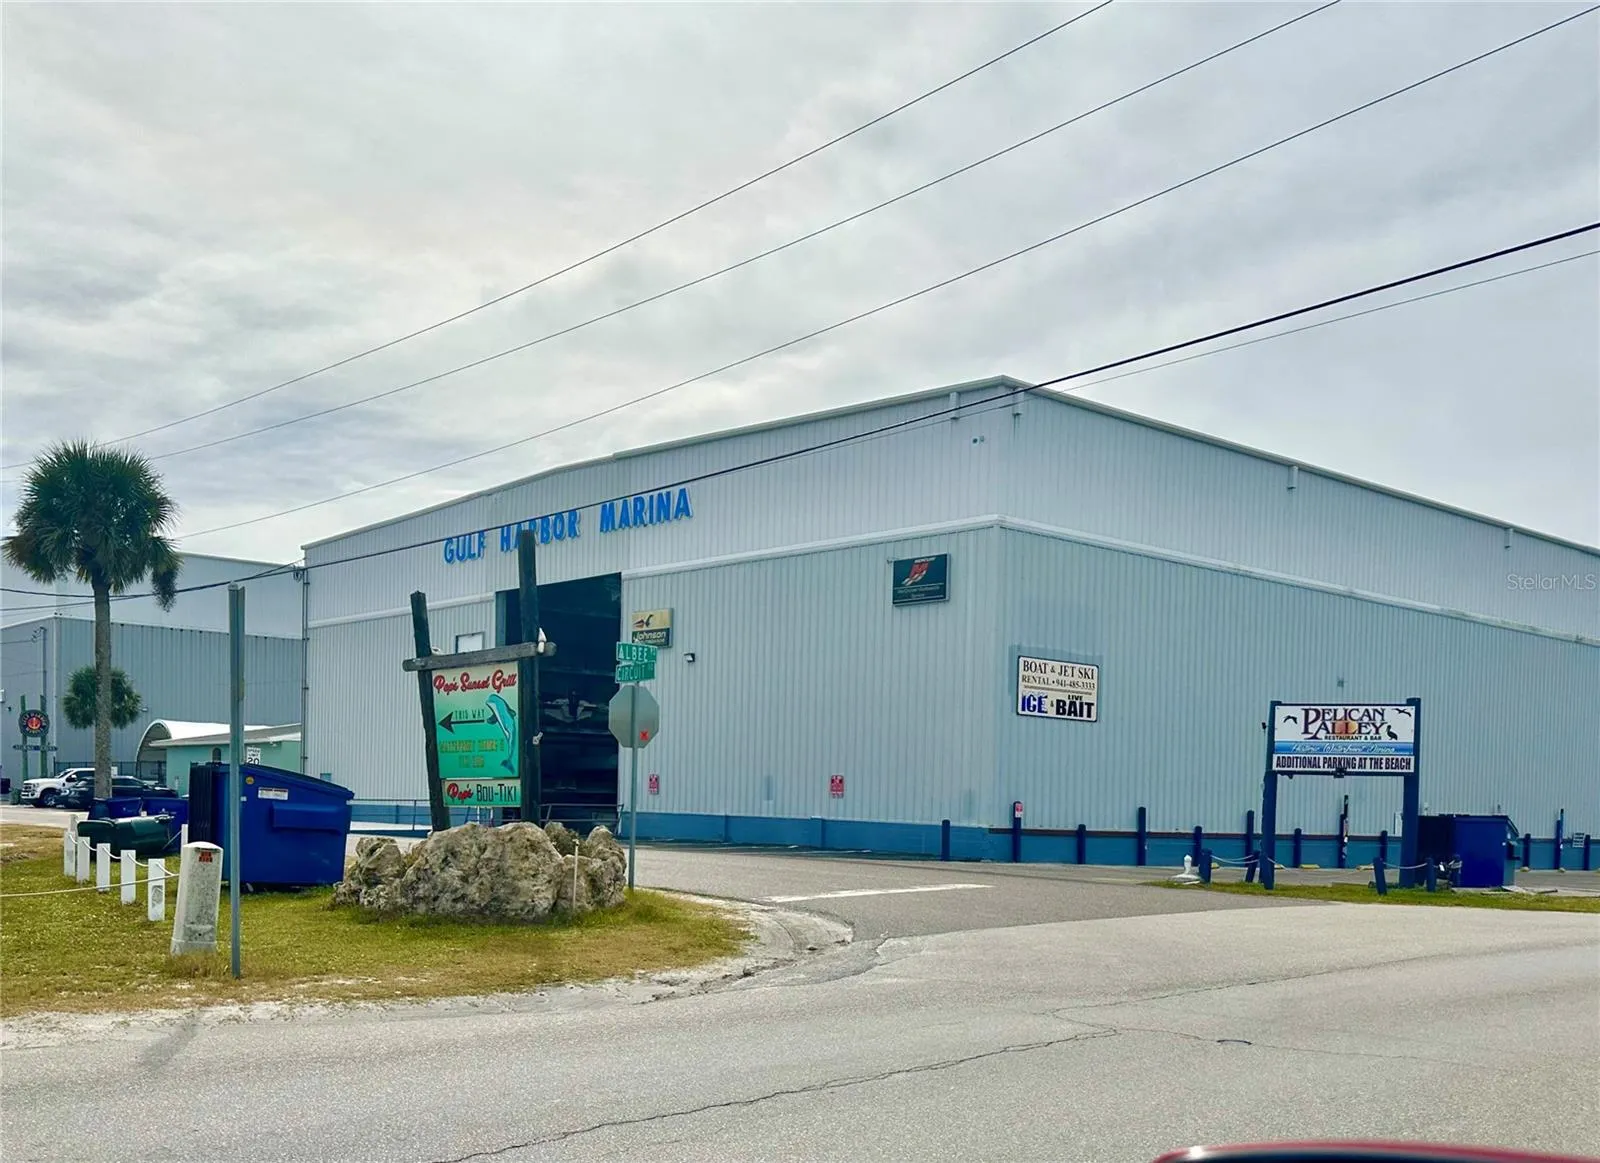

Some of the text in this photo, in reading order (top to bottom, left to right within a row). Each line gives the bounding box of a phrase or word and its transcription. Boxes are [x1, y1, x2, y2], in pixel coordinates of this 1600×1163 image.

[443, 531, 487, 564] GULF
[599, 487, 693, 534] MARINA
[633, 631, 667, 642] Johnson
[618, 645, 648, 662] ALBEE
[617, 664, 646, 681] CIRCUIT
[1023, 660, 1095, 680] BOAT & JET SKI
[460, 671, 490, 692] Sunset
[491, 669, 517, 694] Grill
[1022, 675, 1050, 686] RENTAL
[1021, 693, 1048, 714] ICE
[1055, 698, 1095, 718] BAIT
[1301, 707, 1386, 735] PELICAN
[1303, 720, 1389, 741] ALLEY
[247, 757, 260, 766] 20
[1275, 756, 1411, 770] ADDITIONAL PARKING AT THE BEACH
[476, 783, 517, 802] BOU-TIKI
